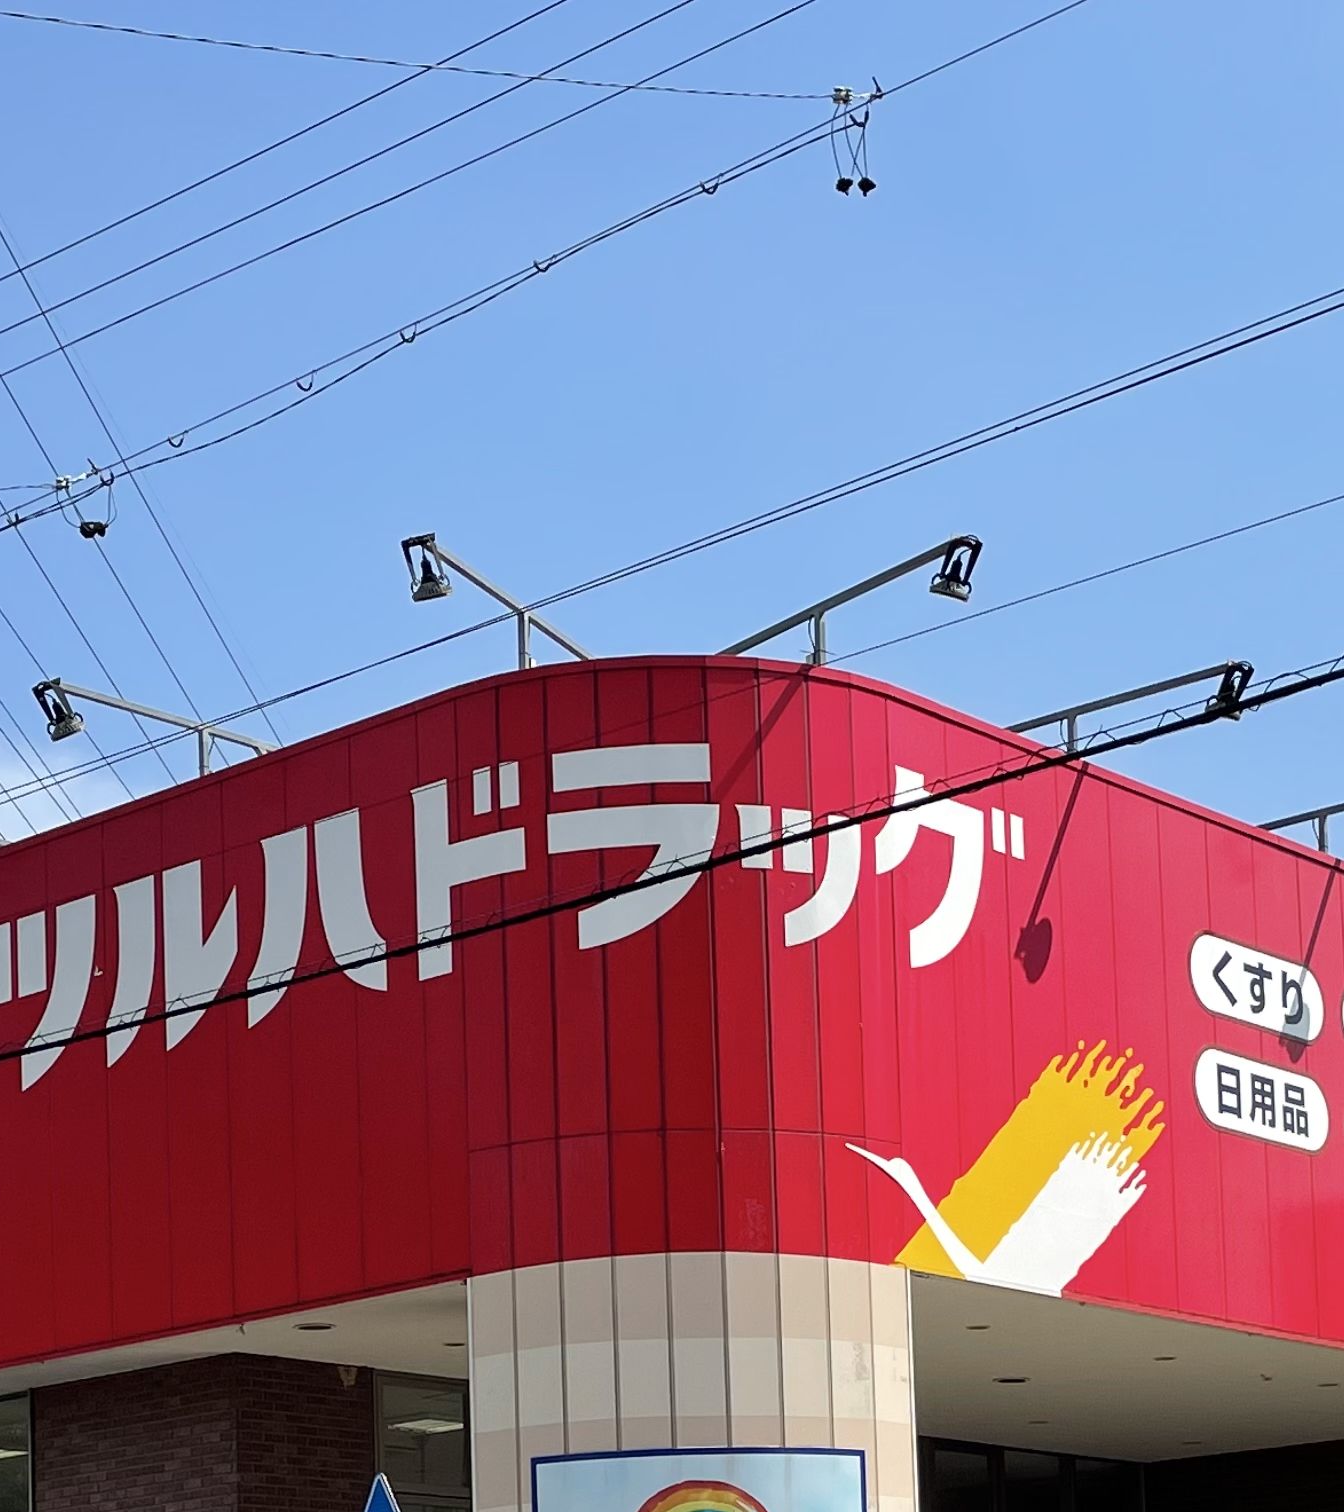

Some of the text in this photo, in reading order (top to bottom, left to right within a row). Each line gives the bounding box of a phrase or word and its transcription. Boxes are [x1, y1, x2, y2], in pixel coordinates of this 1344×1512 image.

[1212, 950, 1305, 1025] くすり
[1216, 1063, 1310, 1138] 日用品
